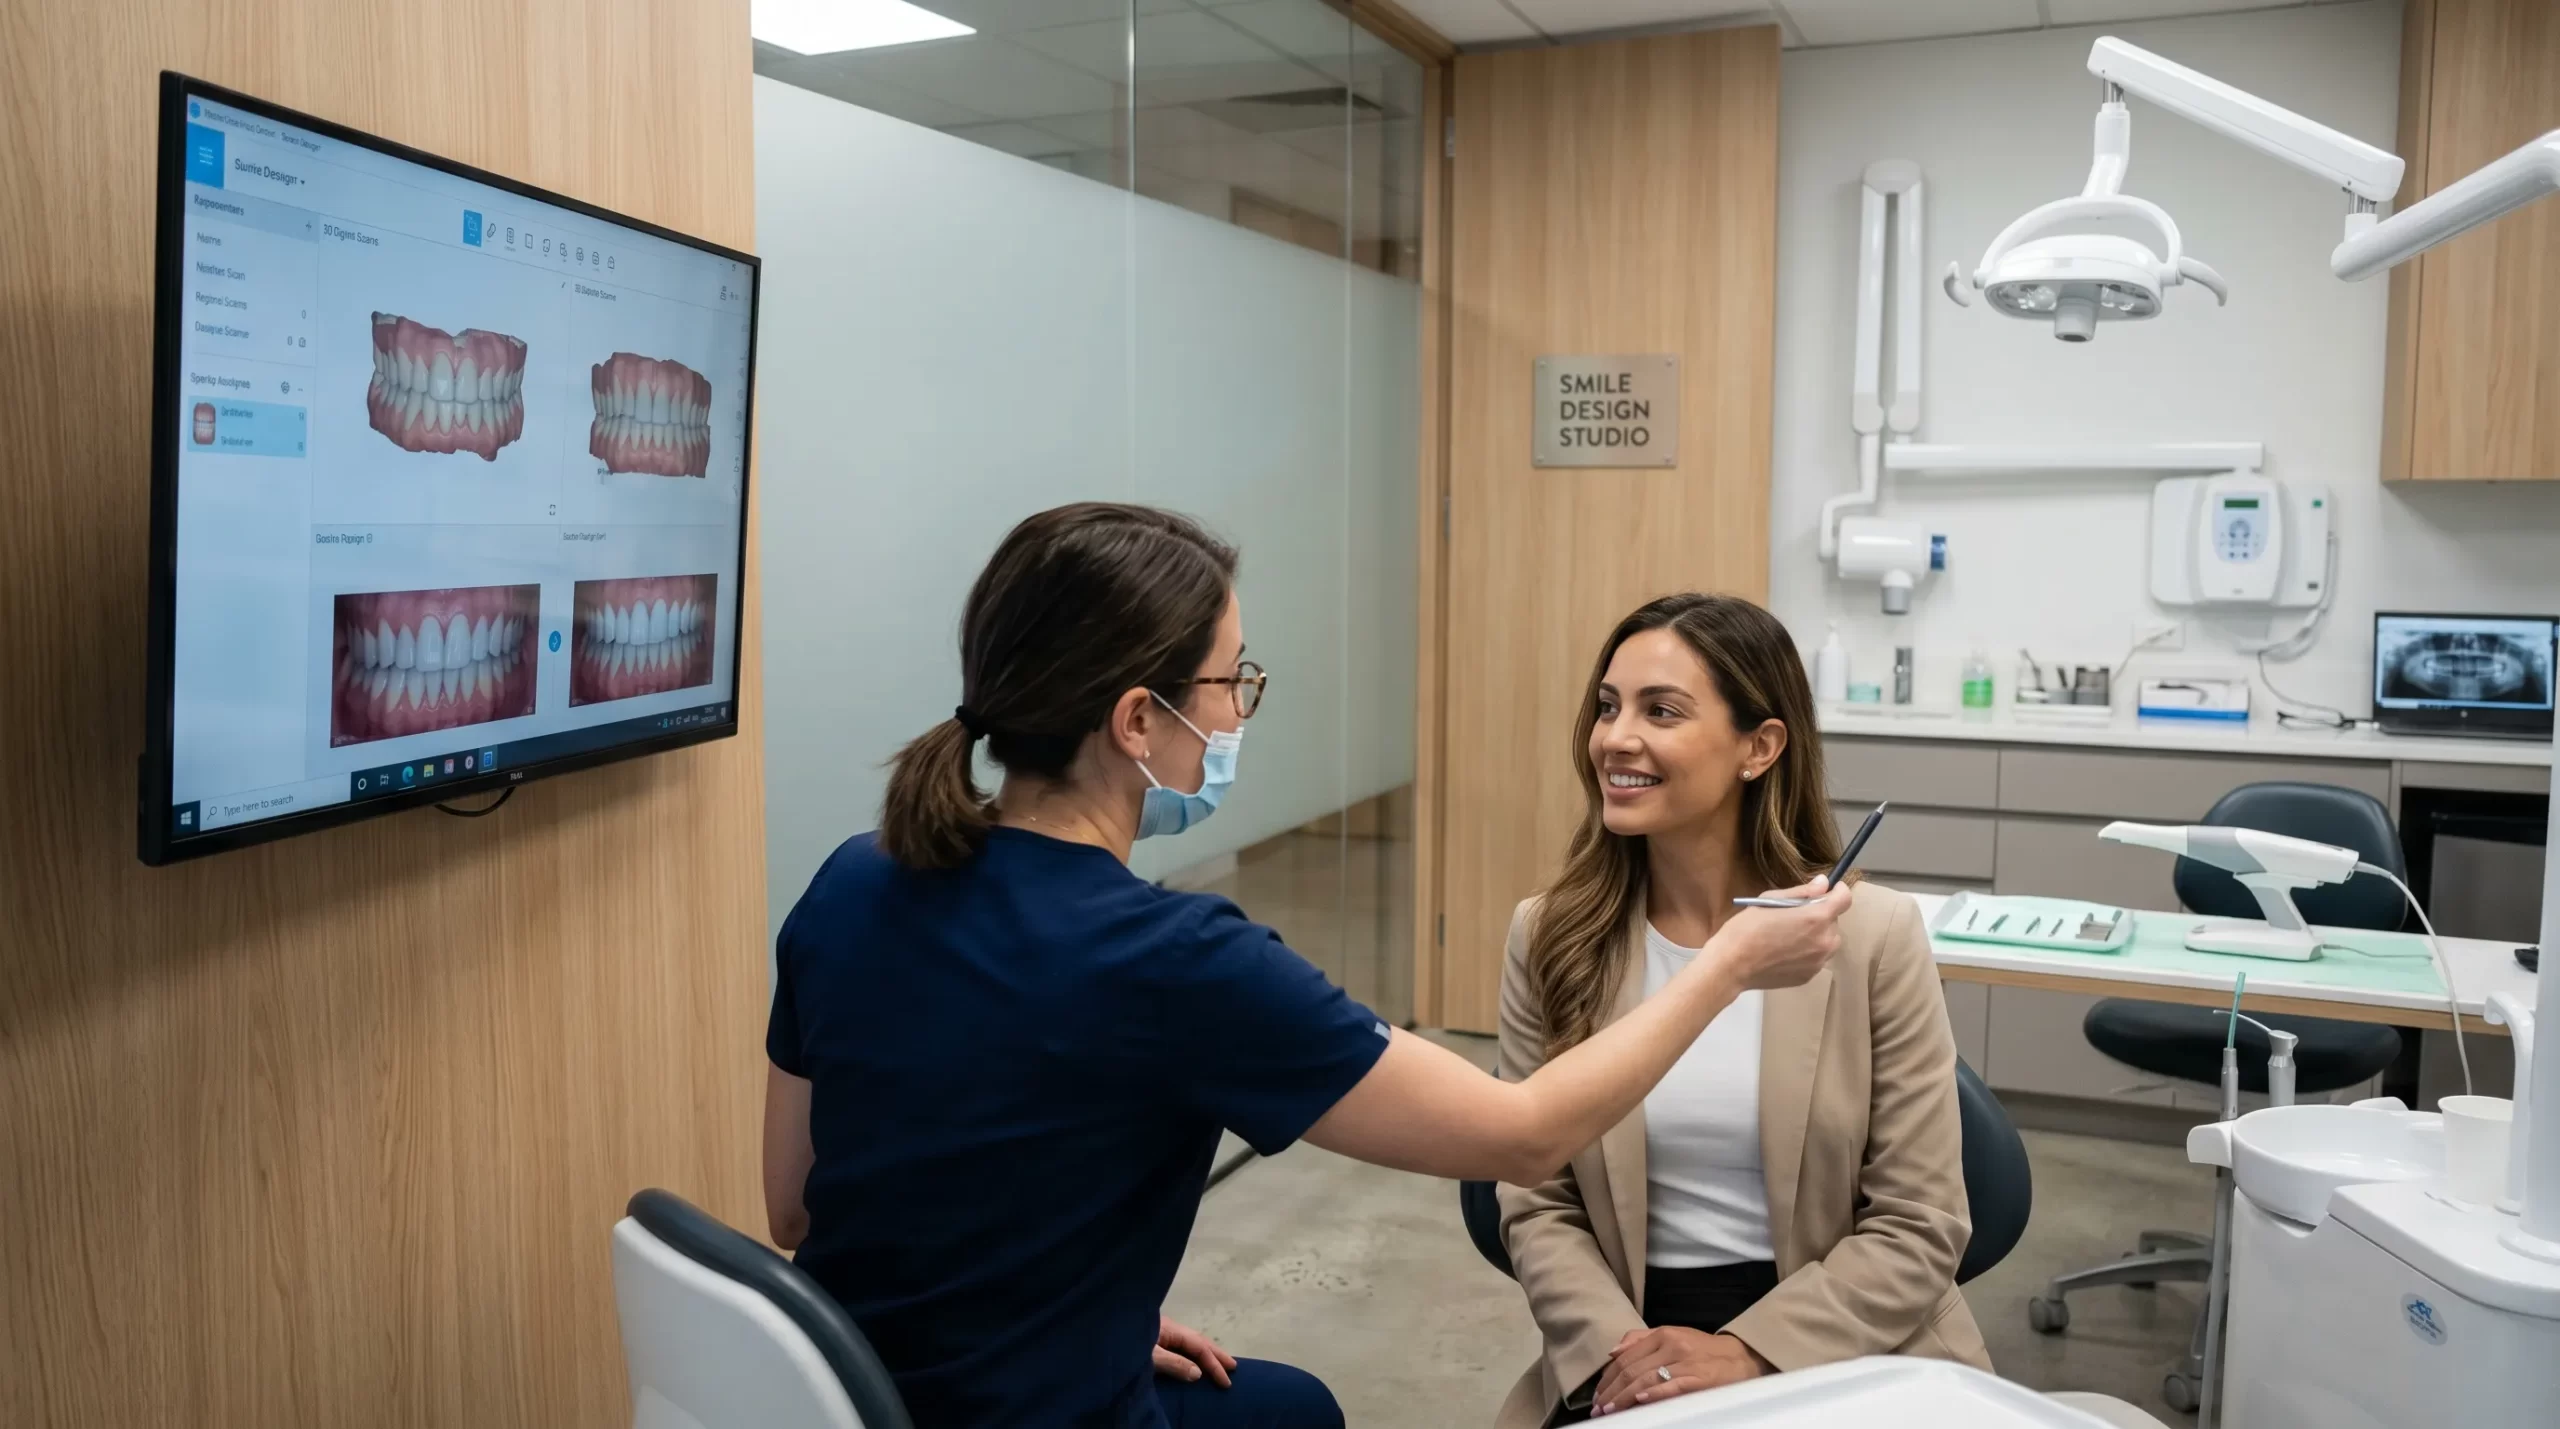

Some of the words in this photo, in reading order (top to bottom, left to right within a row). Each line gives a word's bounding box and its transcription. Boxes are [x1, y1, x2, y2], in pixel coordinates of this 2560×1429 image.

[1560, 373, 1632, 395] SMILE
[1560, 400, 1650, 421] DESIGN
[1560, 426, 1650, 448] STUDIO
[223, 805, 241, 818] Type
[241, 801, 260, 813] here
[261, 800, 270, 810] to
[270, 794, 294, 808] search
